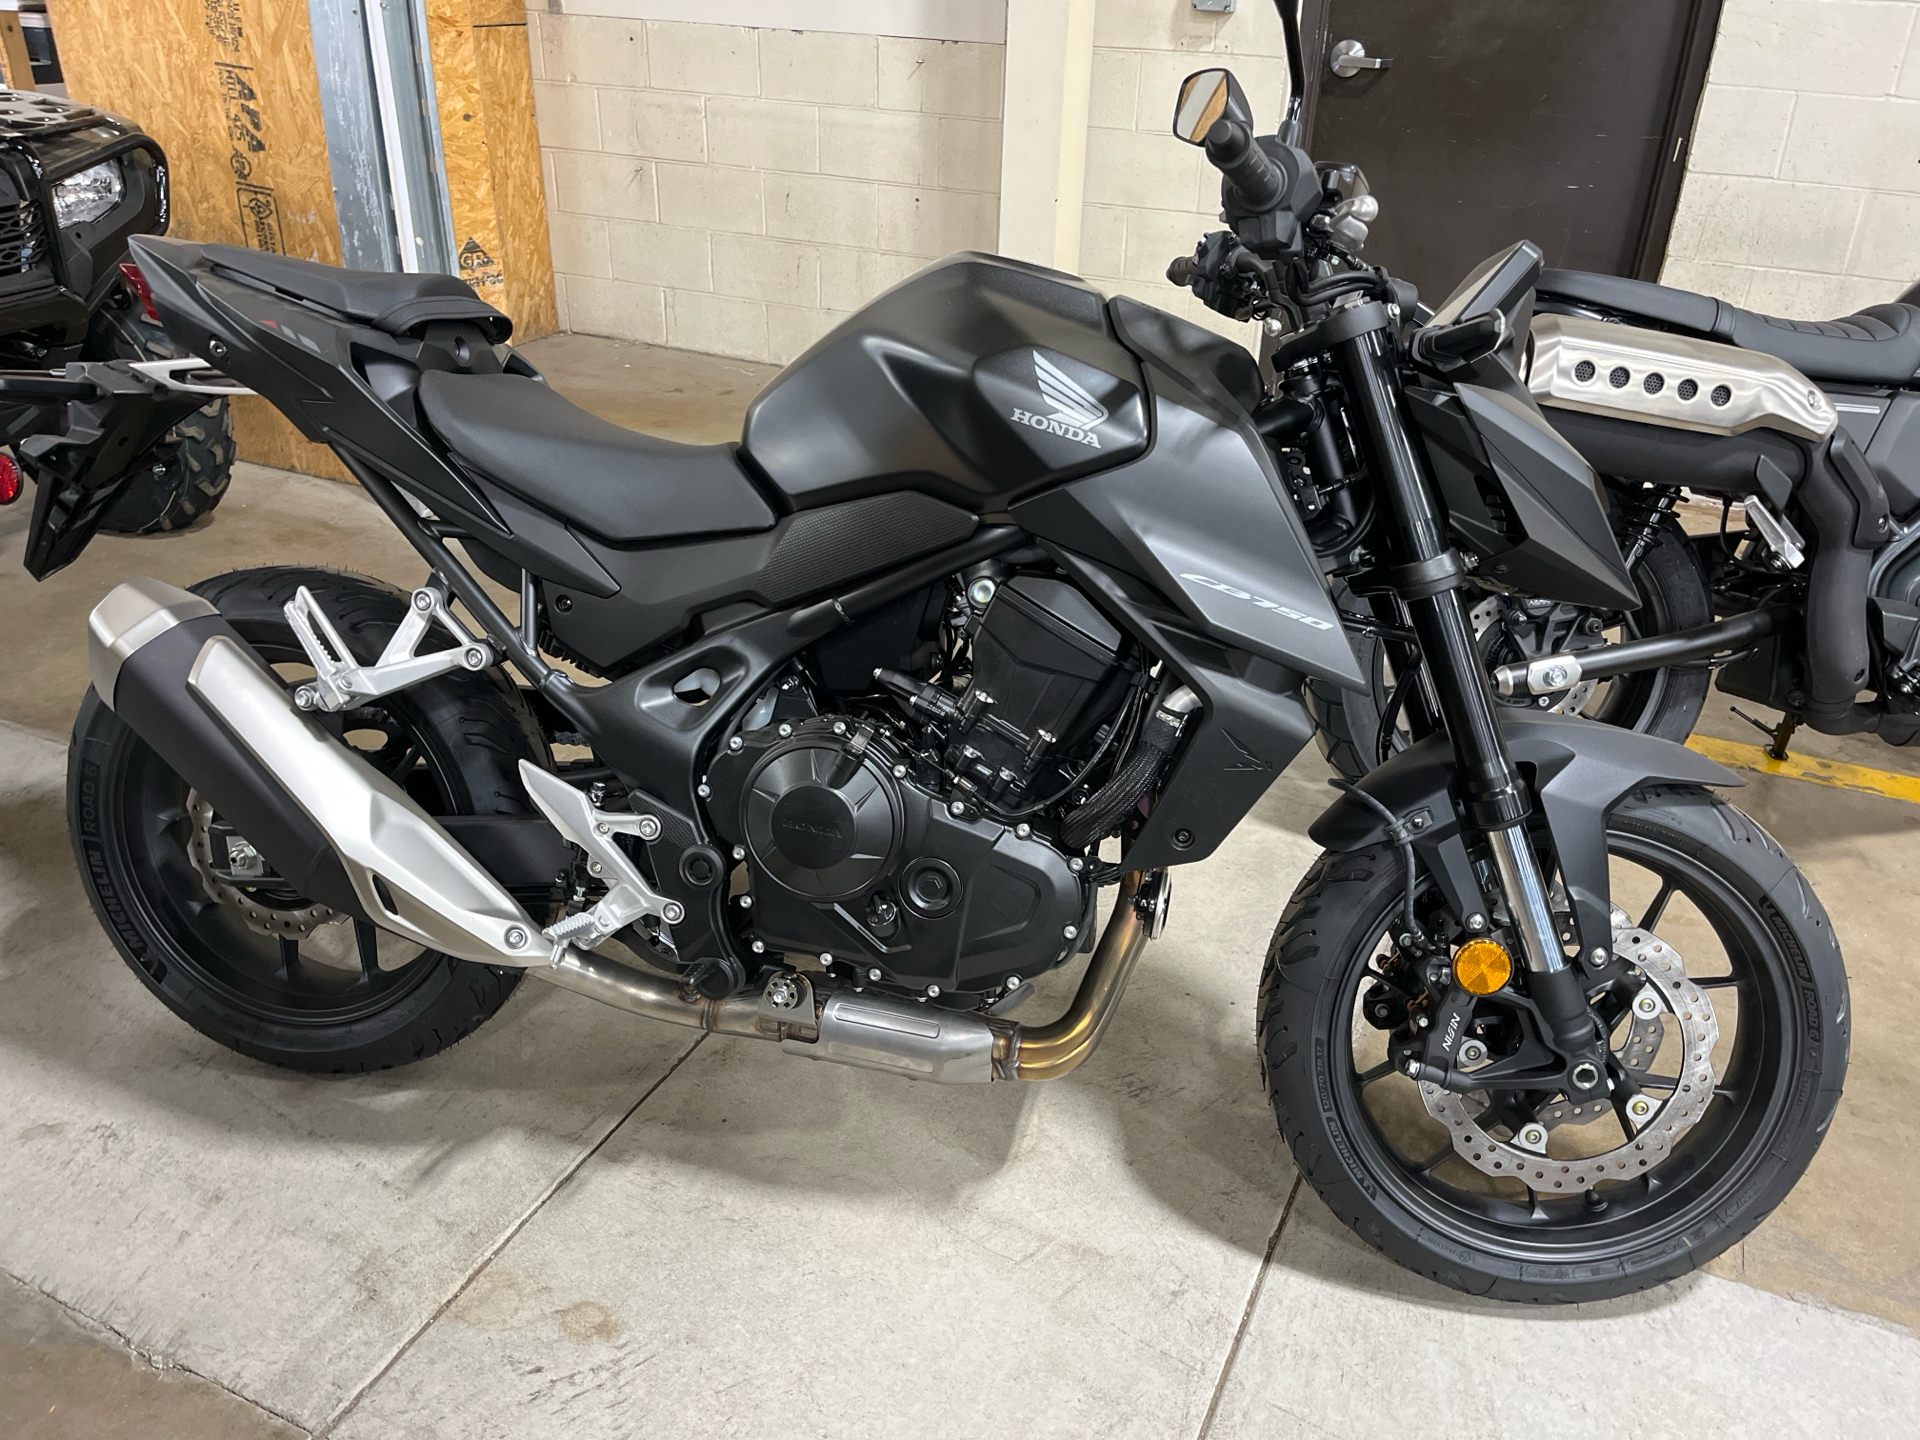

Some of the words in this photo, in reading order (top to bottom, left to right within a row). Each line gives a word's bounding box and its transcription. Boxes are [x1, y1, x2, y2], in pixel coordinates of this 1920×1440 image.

[225, 69, 239, 104] MILL
[235, 72, 266, 154] APA
[1010, 407, 1102, 449] HONDA
[1179, 573, 1334, 631] CB750
[84, 764, 98, 777] 6
[83, 781, 98, 834] ROAD
[88, 849, 144, 949] MICHELIN
[1772, 916, 1810, 982] MICHELIN
[1804, 989, 1818, 1027] ROAD
[1316, 1045, 1323, 1057] 17
[1442, 1012, 1460, 1052] NISSIN
[1809, 1029, 1819, 1039] 6
[1316, 1058, 1325, 1074] ZR
[1318, 1076, 1331, 1110] 120/70
[1328, 1121, 1364, 1179] MICHELIN
